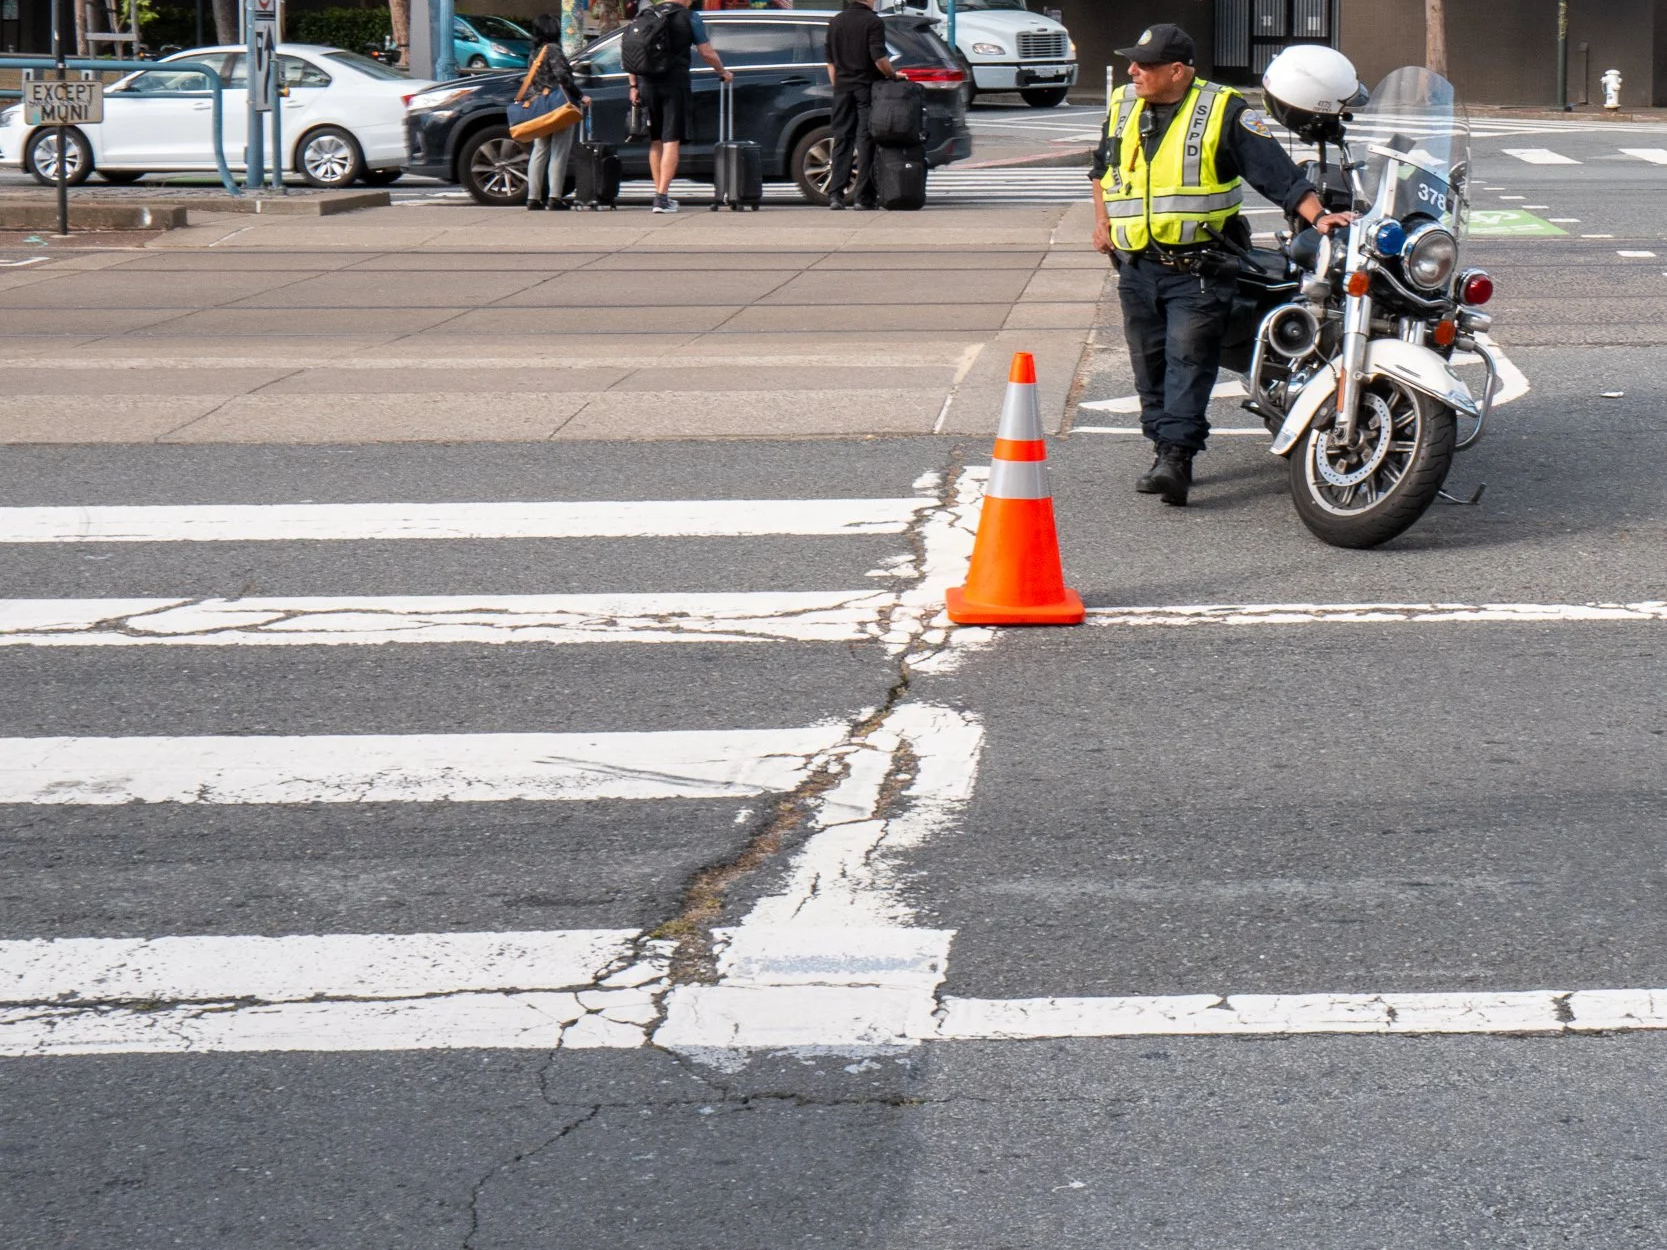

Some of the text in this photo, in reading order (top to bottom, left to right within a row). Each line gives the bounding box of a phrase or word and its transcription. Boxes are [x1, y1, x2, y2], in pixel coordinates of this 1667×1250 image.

[33, 84, 96, 101] EXCEPT
[41, 105, 88, 121] MUNI
[1187, 105, 1208, 157] SFPD
[1418, 183, 1446, 212] 378
